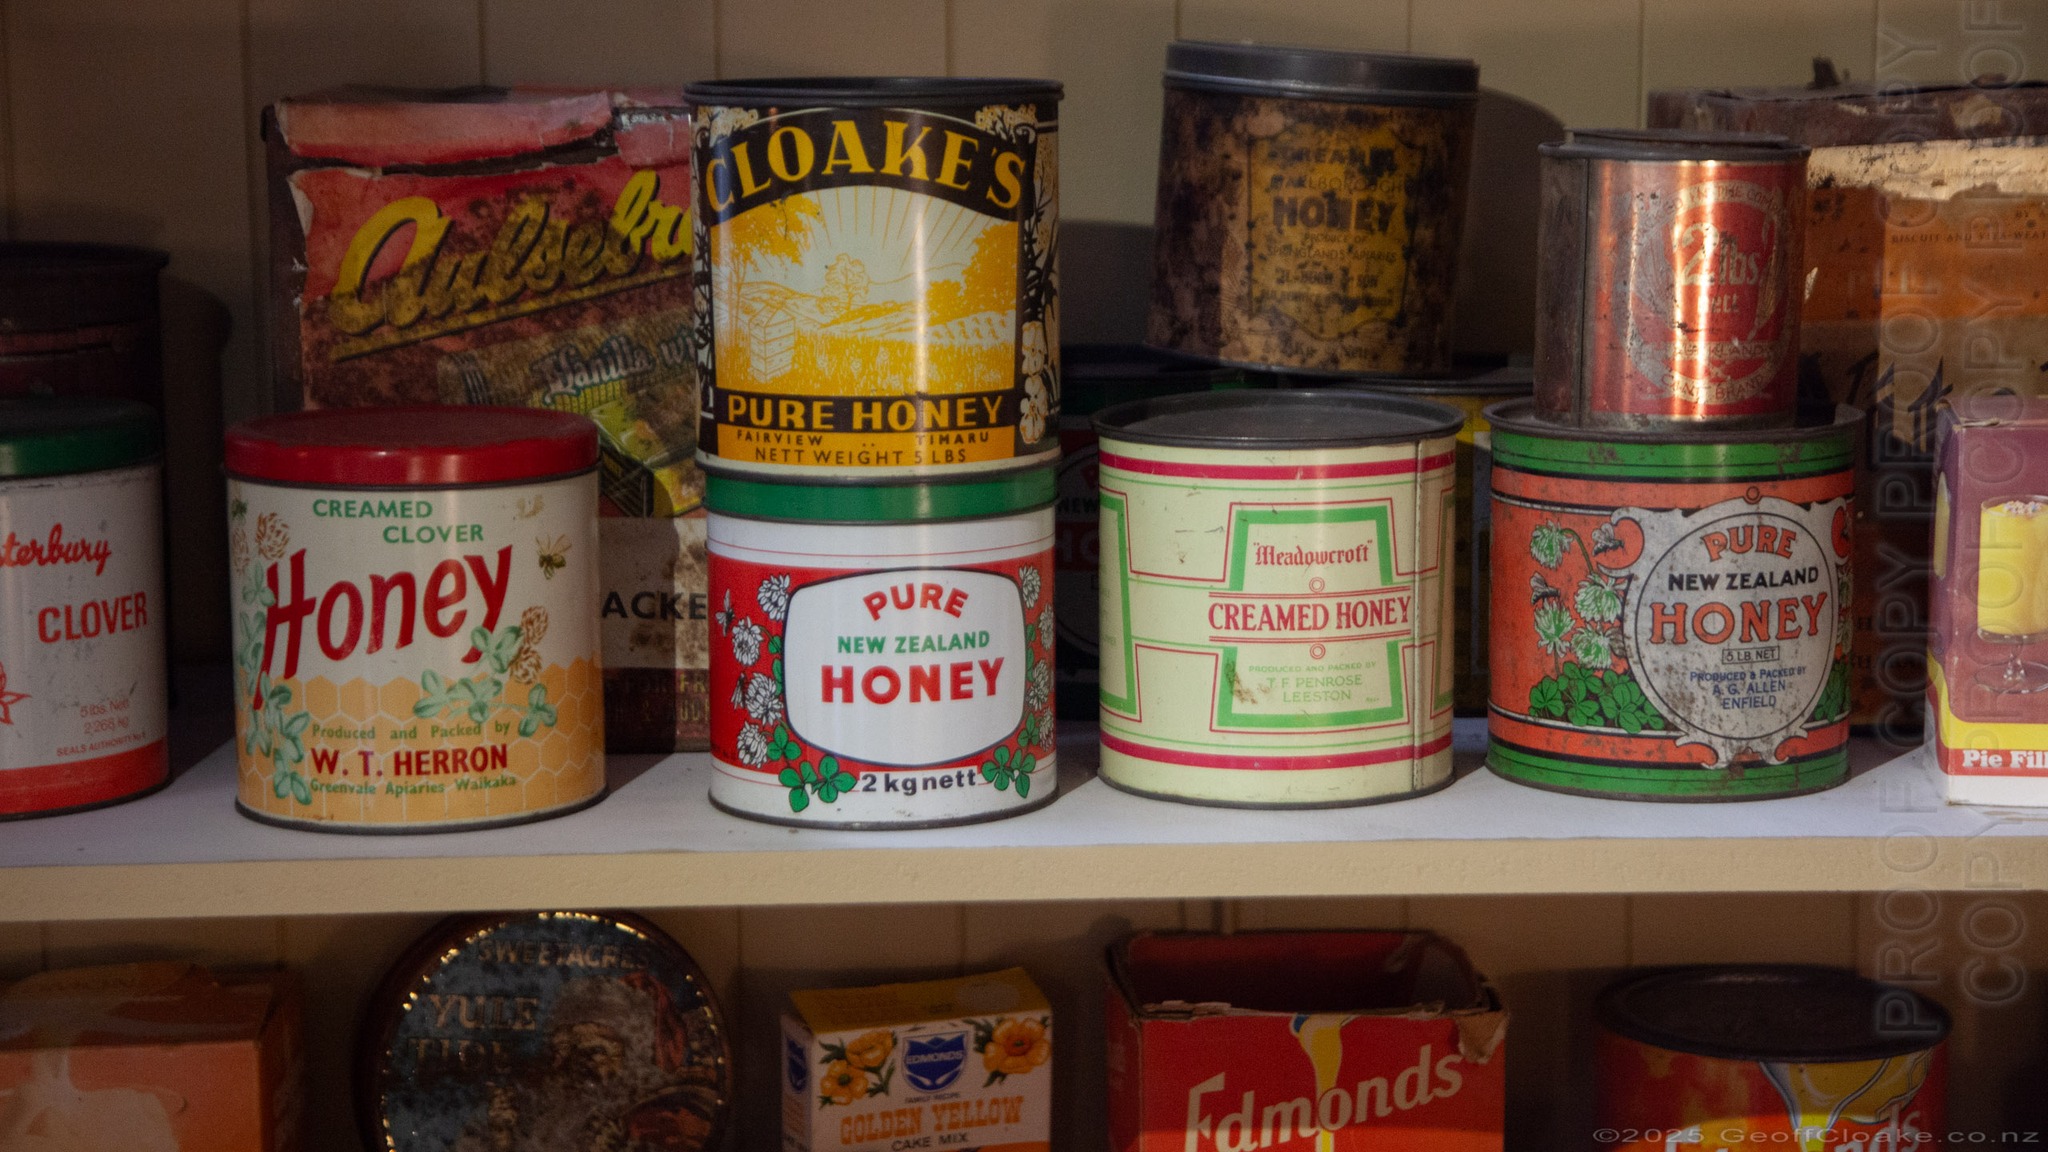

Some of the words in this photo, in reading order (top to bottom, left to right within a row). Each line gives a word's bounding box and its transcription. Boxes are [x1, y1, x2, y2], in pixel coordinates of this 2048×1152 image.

[705, 120, 1026, 214] CLOAKE'S
[1273, 195, 1398, 233] HONEY
[543, 335, 657, 405] Vanilla
[728, 394, 834, 430] PURE
[852, 395, 1003, 431] HONEY
[737, 429, 823, 447] FAIRVIEW
[915, 431, 989, 446] TIMARU
[755, 447, 804, 463] NETT
[813, 449, 903, 465] WEIGHT
[914, 450, 923, 464] 5
[932, 449, 966, 464] LBS
[312, 498, 433, 520] CREAMED
[382, 523, 485, 544] CLOVER
[1702, 525, 1798, 563] PURE
[1668, 573, 1719, 591] NEW
[1726, 565, 1819, 590] ZEALAND
[862, 583, 969, 621] PURE
[1208, 602, 1329, 631] CREAMED
[1336, 595, 1412, 630] HONEY
[37, 590, 148, 644] CLOVER
[252, 544, 514, 711] Honey
[1649, 591, 1828, 645] HONEY
[837, 635, 886, 654] NEW
[894, 629, 991, 653] ZEALAND
[1726, 650, 1734, 661] 5
[1755, 648, 1776, 660] NET
[1249, 665, 1302, 673] PRODUCED
[1305, 664, 1325, 672] AND
[1328, 662, 1363, 672] PACKED
[1690, 671, 1747, 682] PRODUCED
[820, 657, 1005, 705] HONEY
[1295, 674, 1363, 689] PENROSE
[1746, 680, 1786, 695] ALLEN
[1283, 689, 1352, 703] LEESTON
[1722, 695, 1777, 710] ENFIELD
[312, 724, 376, 740] Produced
[389, 725, 418, 740] and
[430, 723, 482, 738] Packed
[494, 720, 511, 735] by
[56, 743, 88, 757] SEALS
[310, 747, 349, 776] W.
[357, 750, 383, 777] T.
[393, 743, 508, 777] HERRON
[1962, 749, 2003, 769] Pie
[310, 778, 377, 795] Greenvale
[385, 781, 446, 798] Apiaries
[454, 774, 517, 792] Waikaka
[861, 772, 878, 793] 2
[906, 1049, 964, 1066] EDMONDS
[1184, 1044, 1465, 1152] Edmonds
[840, 1105, 923, 1146] GOLDEN
[931, 1095, 1025, 1132] YELLOW
[891, 1136, 932, 1152] CAKE
[938, 1131, 970, 1146] MIX
